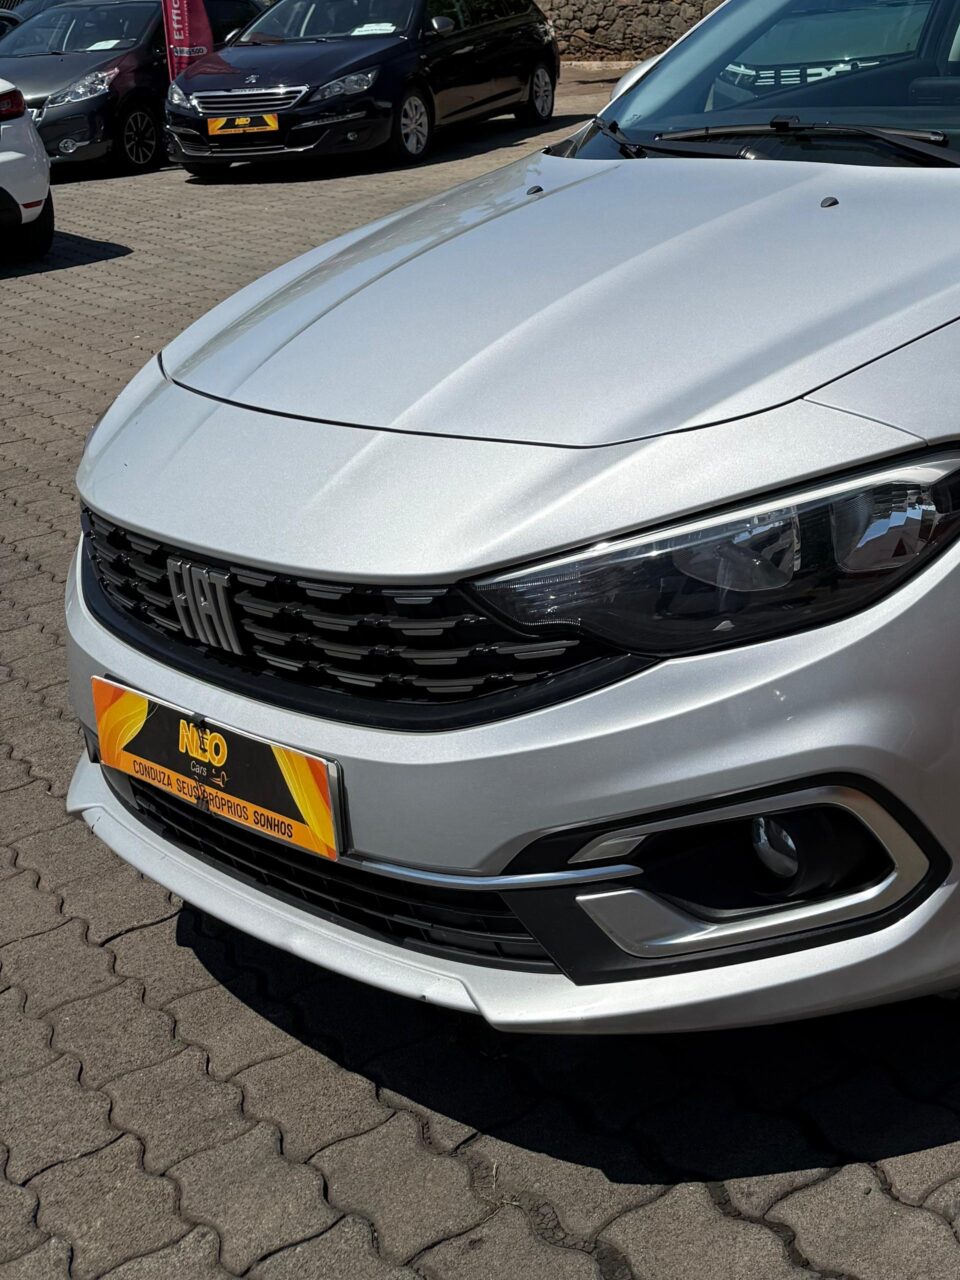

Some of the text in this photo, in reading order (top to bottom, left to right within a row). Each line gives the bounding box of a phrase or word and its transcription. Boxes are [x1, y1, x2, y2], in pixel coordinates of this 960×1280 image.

[167, 558, 243, 654] FIAT
[179, 719, 228, 767] NEO
[190, 761, 207, 776] Cars
[133, 760, 293, 838] CONDUZA SEUS PRÓPRIOS SONHOS
